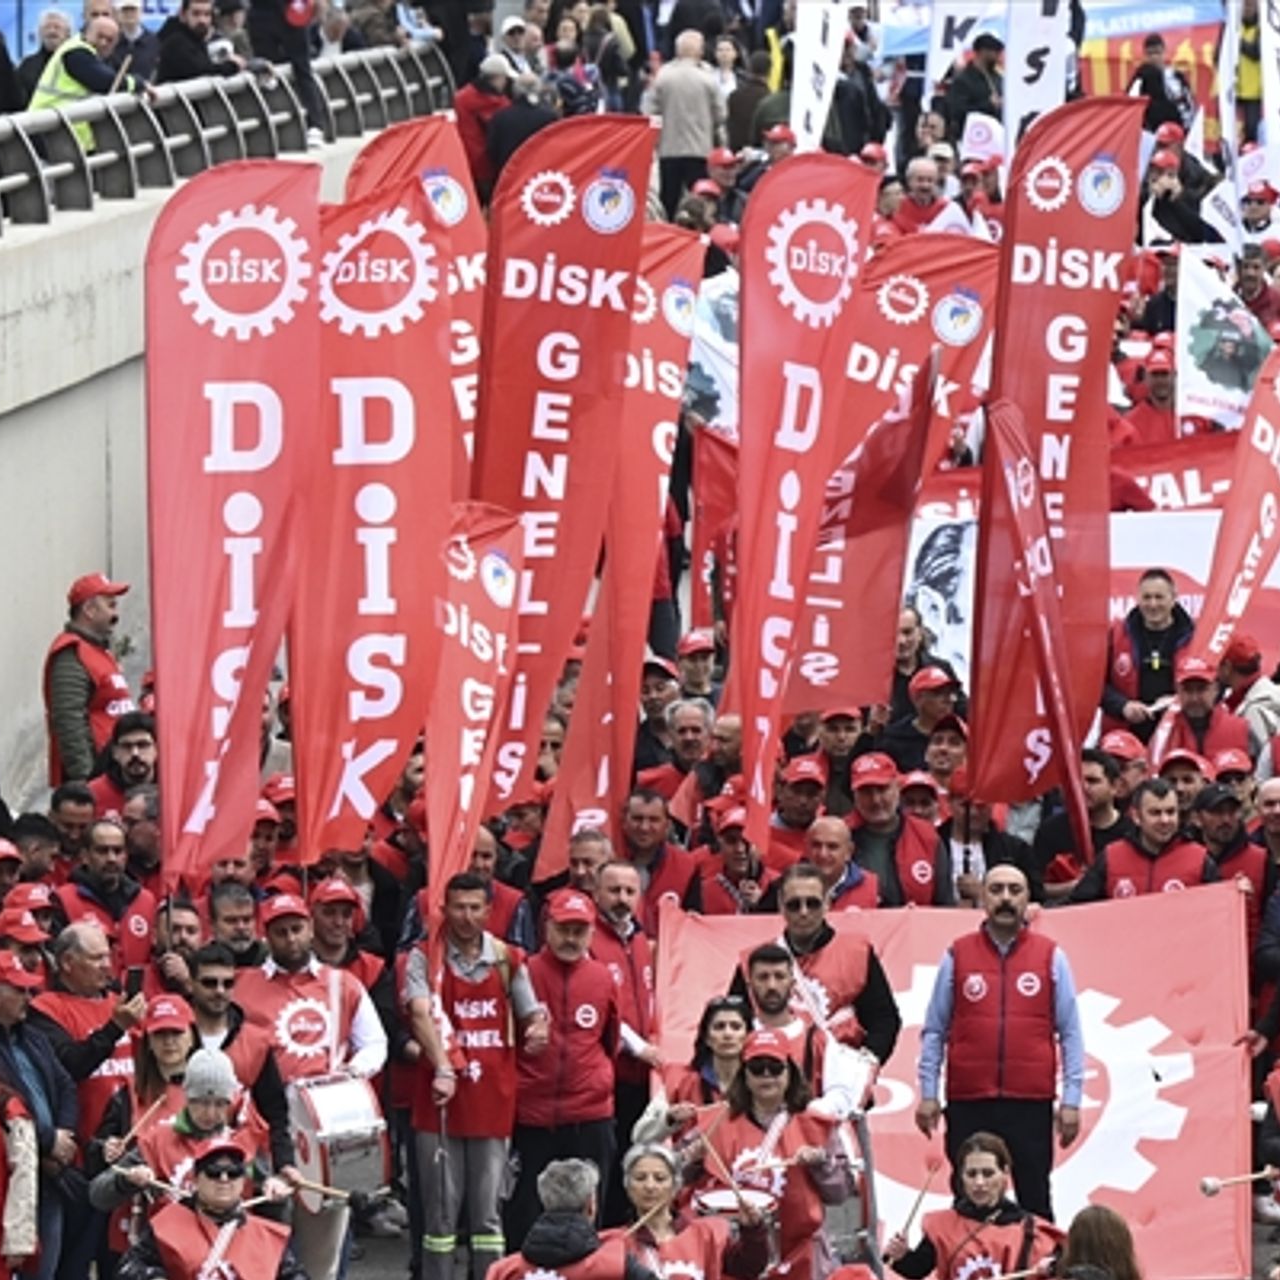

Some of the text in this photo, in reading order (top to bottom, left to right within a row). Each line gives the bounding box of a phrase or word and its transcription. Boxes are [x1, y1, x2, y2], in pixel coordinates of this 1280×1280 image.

[207, 249, 282, 284] DİSK
[335, 246, 411, 284] DİSK
[789, 239, 845, 277] DİSK
[1012, 238, 1123, 291] DİSK
[502, 253, 629, 310] DİSK
[327, 377, 415, 821] DİSK
